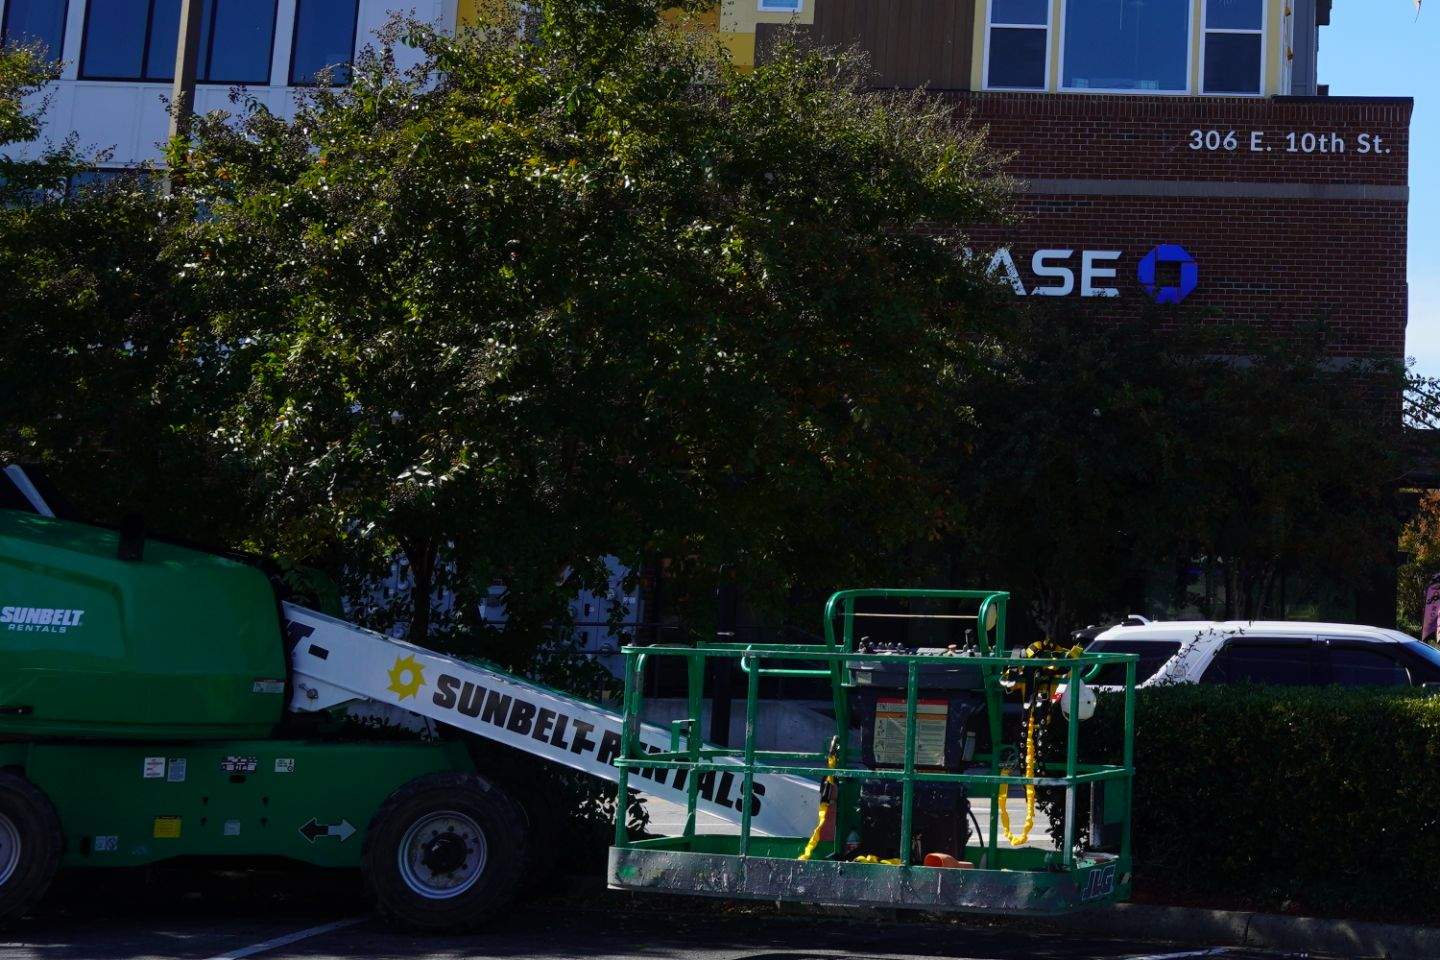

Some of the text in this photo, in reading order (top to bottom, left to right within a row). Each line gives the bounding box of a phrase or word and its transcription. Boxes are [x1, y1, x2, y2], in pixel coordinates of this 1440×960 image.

[1188, 129, 1391, 154] 306 E. 10th St.
[961, 245, 1122, 298] ASE
[0, 606, 85, 626] SUNBELT
[8, 623, 67, 634] RENTALS
